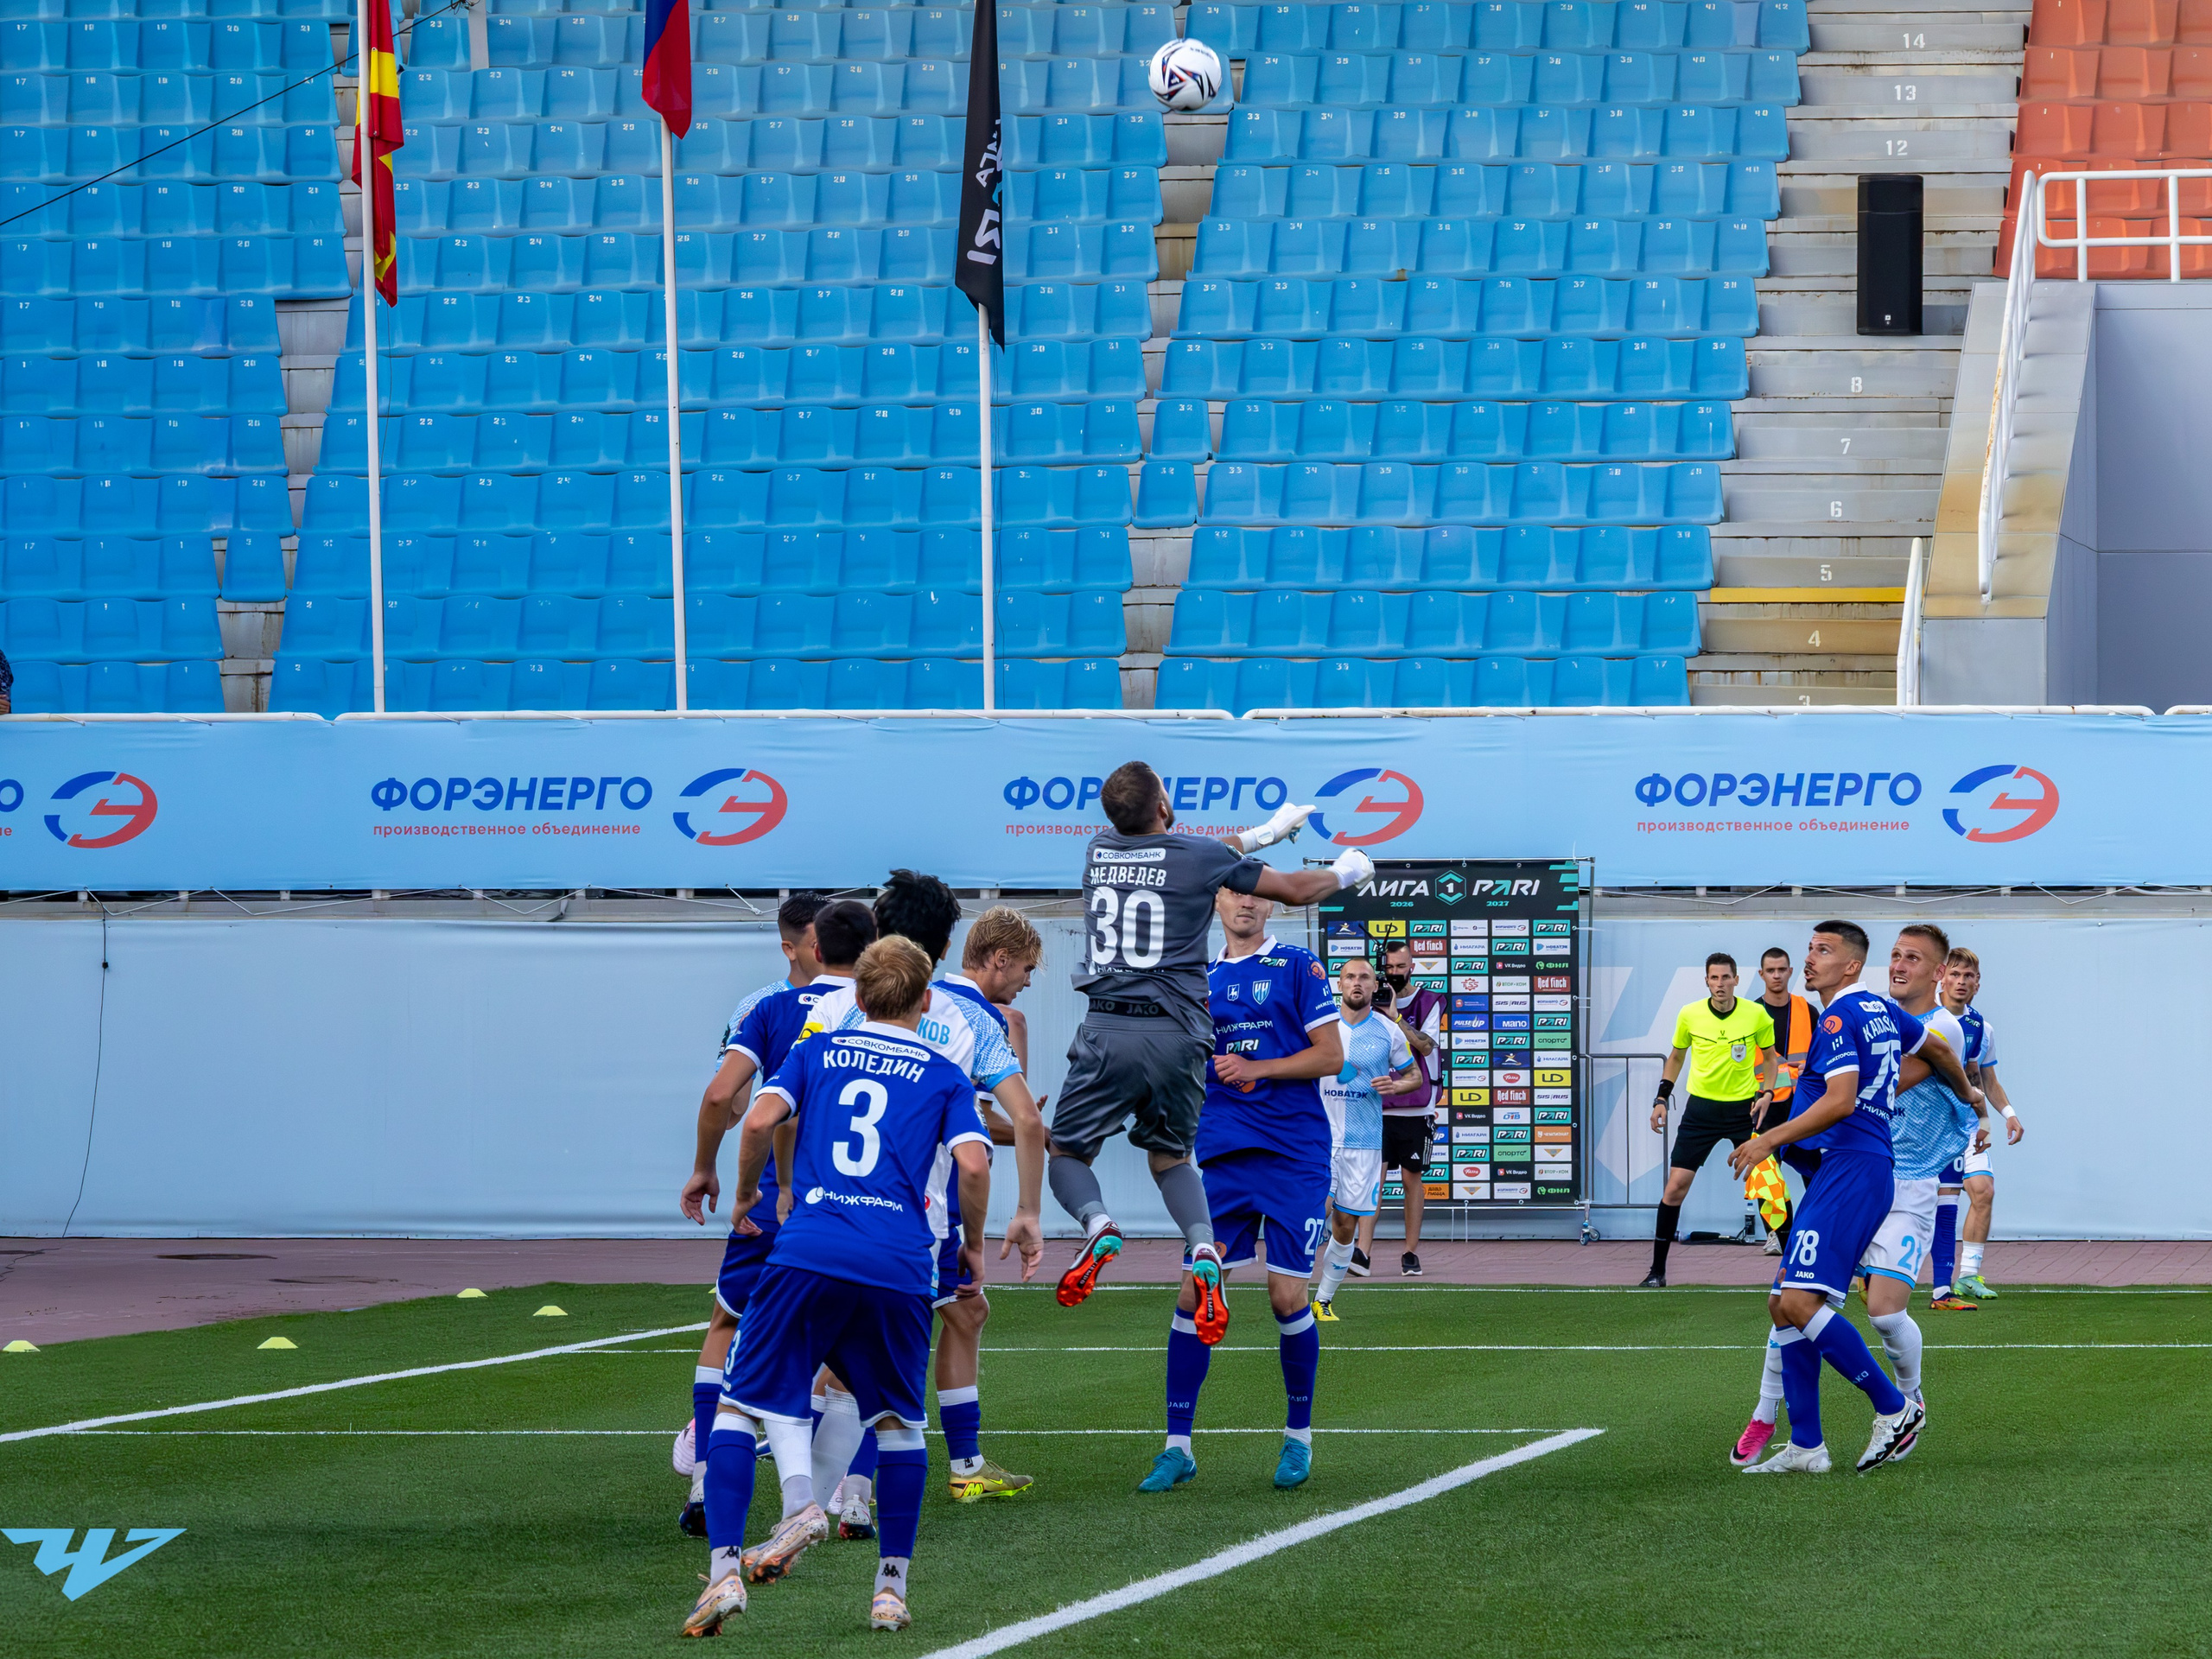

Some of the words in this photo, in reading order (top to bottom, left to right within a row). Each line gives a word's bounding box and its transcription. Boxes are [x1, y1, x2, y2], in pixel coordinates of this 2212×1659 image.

[1206, 6, 1219, 15] 34
[1904, 33, 1926, 48] 14
[1894, 85, 1916, 101] 13
[1247, 112, 1261, 121] 33
[1886, 140, 1908, 156] 12
[454, 238, 467, 247] 23
[1203, 283, 1217, 292] 32
[1851, 377, 1863, 393] 8
[1840, 438, 1851, 454] 7
[1830, 501, 1842, 518] 6
[1821, 564, 1833, 582] 5
[1808, 630, 1821, 646] 4
[371, 776, 652, 811] ФОРЭНЕРГО
[1003, 776, 1288, 811] ФОРЕРГО
[1635, 772, 1923, 807] ФОРЭНЕРГО
[373, 824, 526, 838] производственное
[532, 823, 641, 836] объединение
[1637, 821, 1794, 835] производственное
[1799, 819, 1910, 833] объединение
[1103, 851, 1161, 860] СОВКОМБАНК
[1090, 866, 1166, 887] МЕДВЕДЕВ
[1357, 880, 1430, 897] ЛИГА
[1472, 879, 1541, 896] PARI
[1090, 886, 1165, 968] 30
[1413, 925, 1444, 933] PARI
[1536, 924, 1567, 932] PARI
[1428, 941, 1443, 951] finch
[1259, 956, 1287, 967] PARI
[1455, 962, 1485, 970] PARI
[1414, 981, 1444, 989] PARI
[1550, 977, 1567, 988] finch
[1216, 1020, 1274, 1035] НИЖФАРМ
[1538, 1018, 1567, 1027] PARI
[848, 1039, 925, 1059] СОВКОМБАНК
[1226, 1039, 1259, 1054] PARI
[823, 1049, 925, 1084] КОЛЕДИН
[1325, 1089, 1368, 1099] НОВАТЭК
[1510, 1090, 1527, 1101] finch
[1538, 1111, 1568, 1120] PARI
[832, 1078, 888, 1177] 3
[823, 1190, 904, 1212] НИЖФАРМ
[1305, 1217, 1325, 1255] 27
[1789, 1230, 1820, 1267] 78
[1795, 1270, 1815, 1279] JAKO
